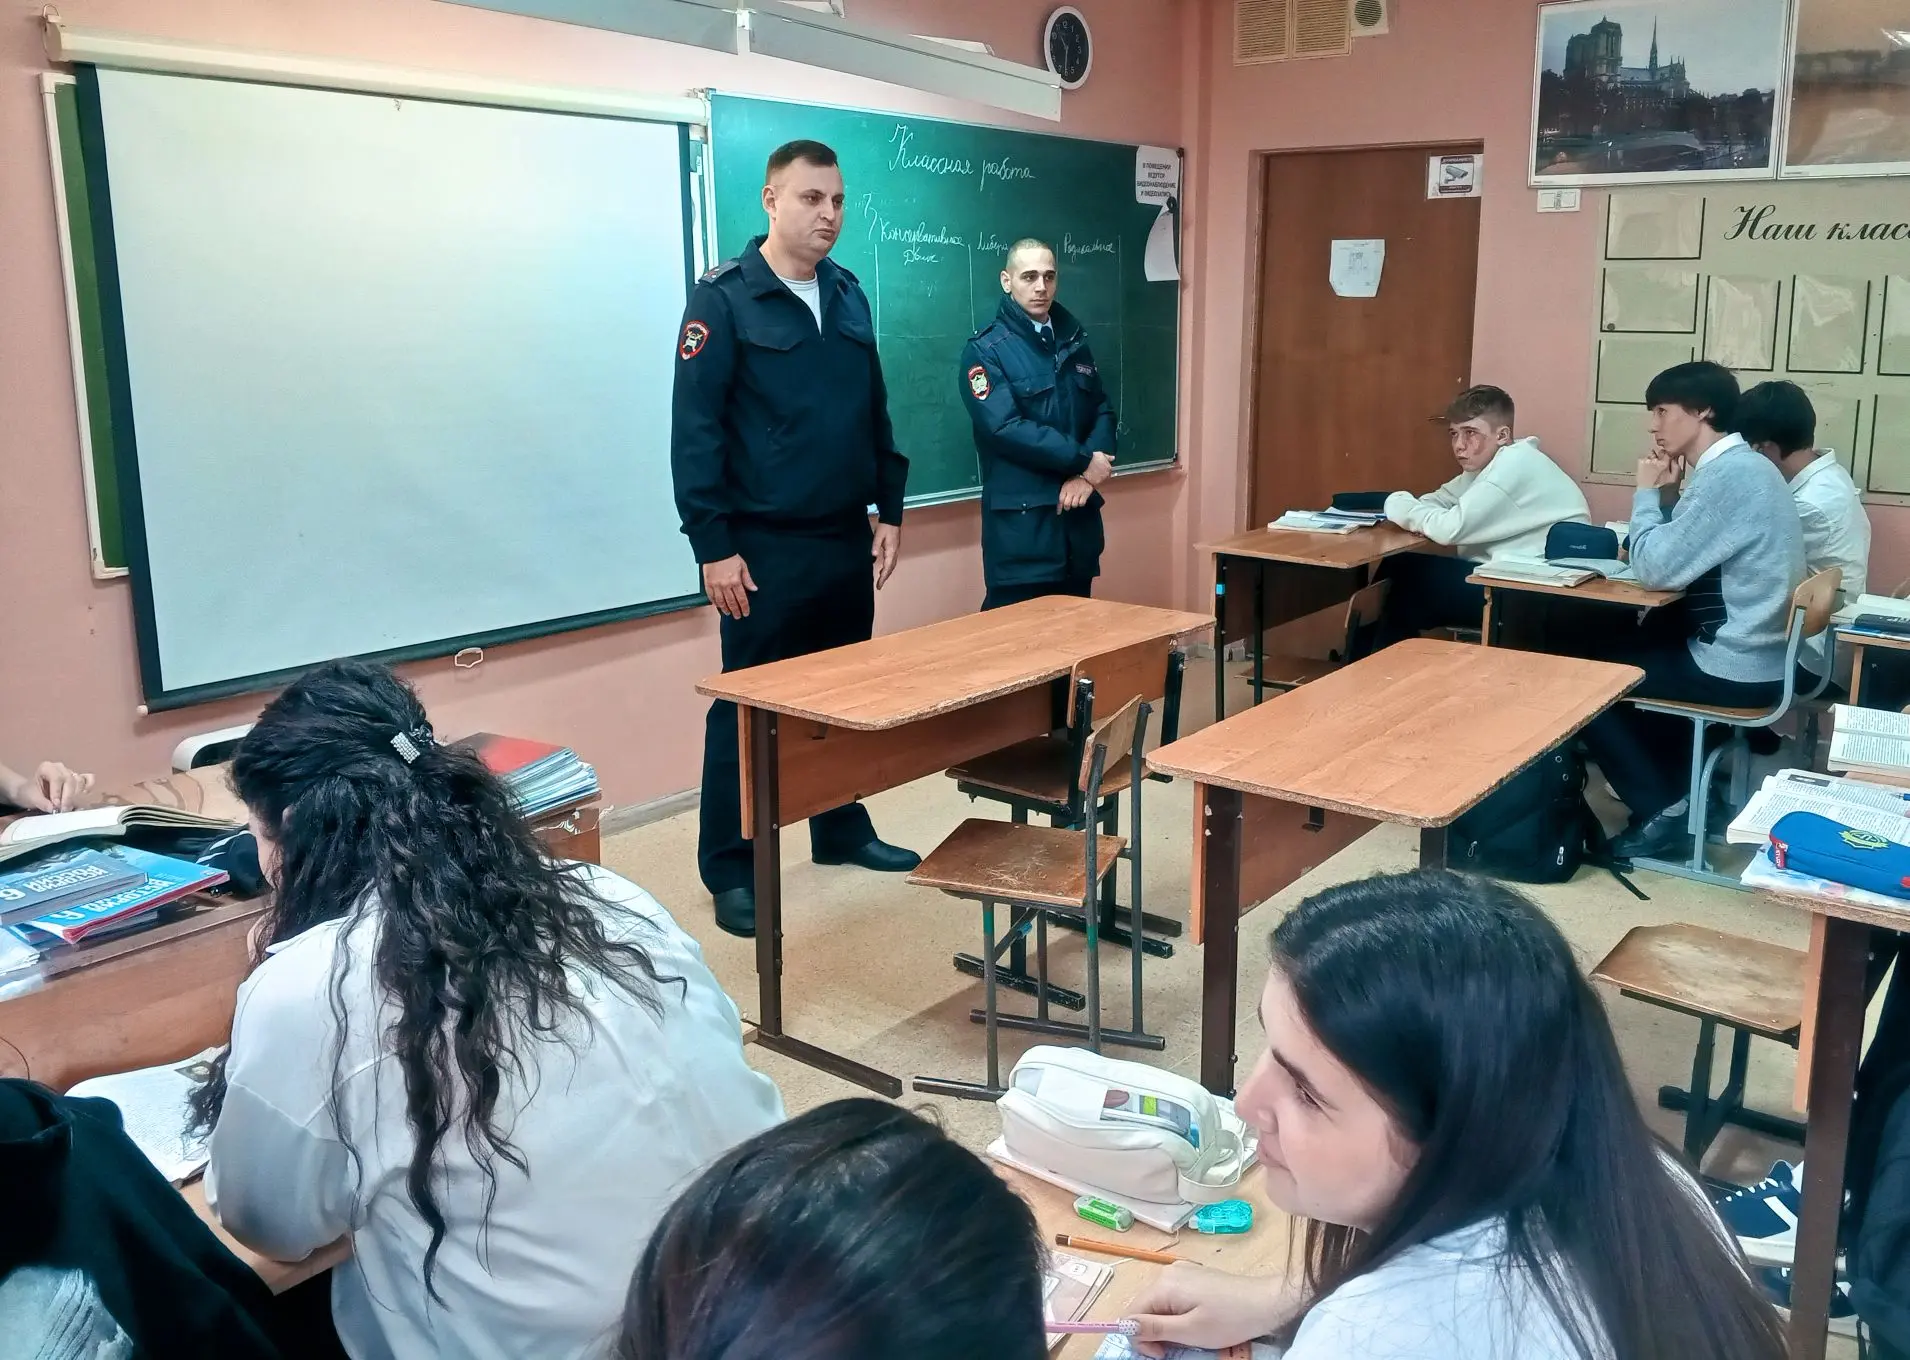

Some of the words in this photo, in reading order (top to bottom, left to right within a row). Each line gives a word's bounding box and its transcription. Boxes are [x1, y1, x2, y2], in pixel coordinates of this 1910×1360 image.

[888, 123, 974, 175] Классная
[979, 156, 1036, 192] работа
[1723, 204, 1818, 241] Наш
